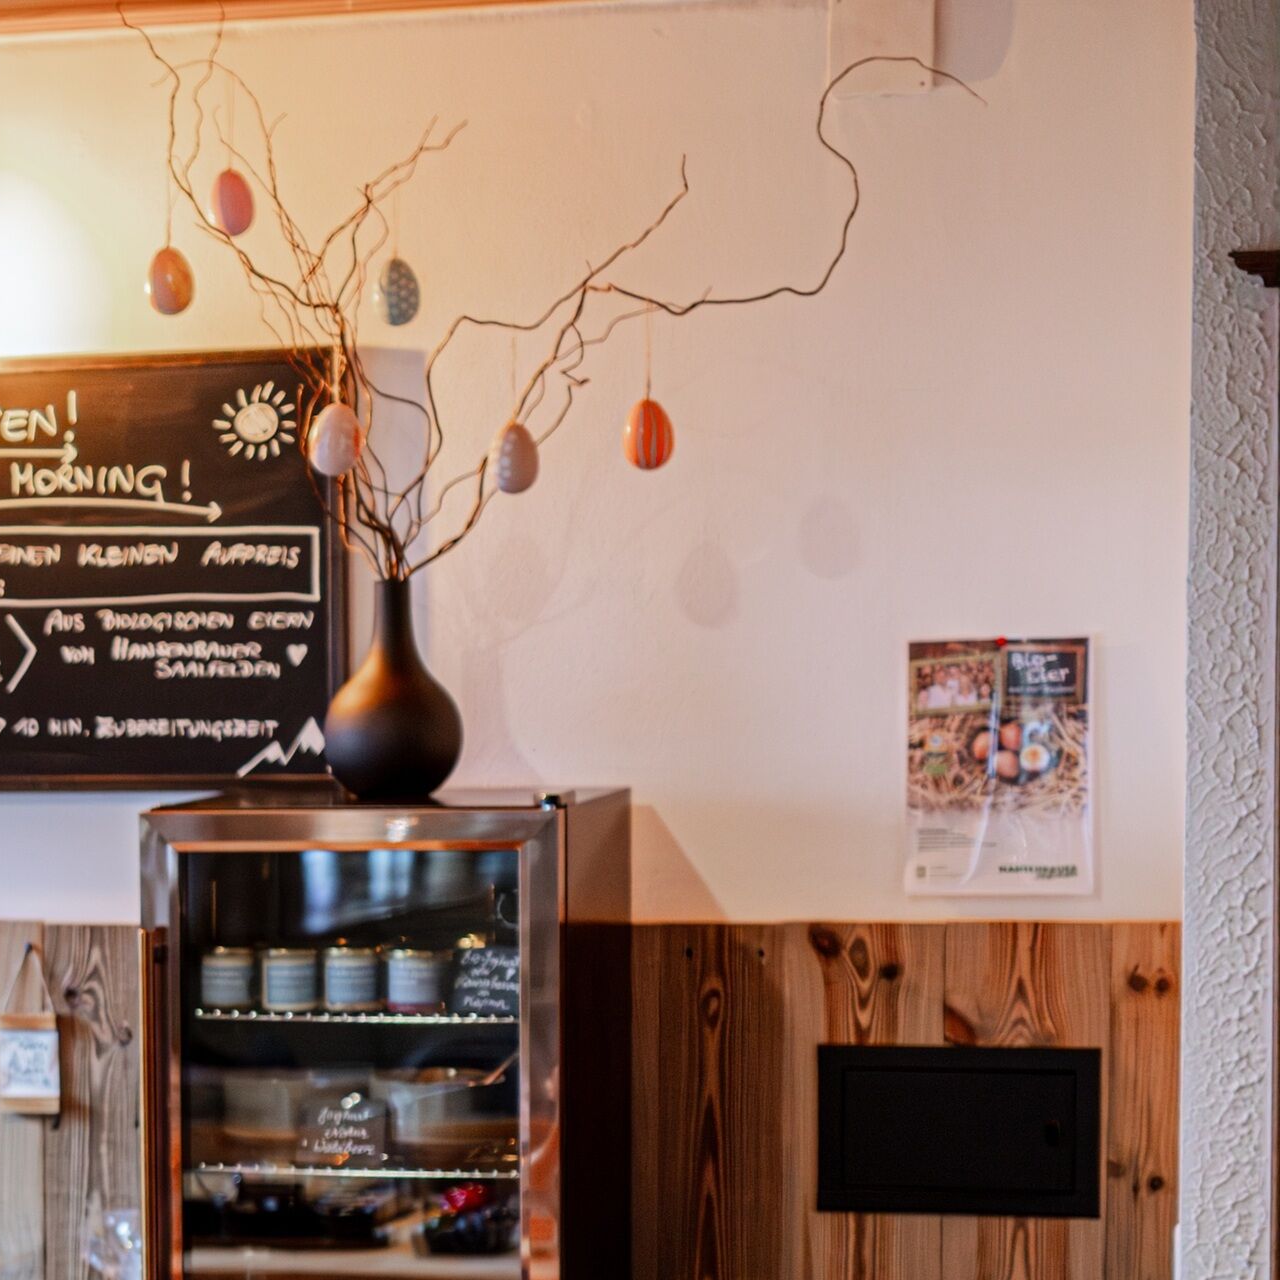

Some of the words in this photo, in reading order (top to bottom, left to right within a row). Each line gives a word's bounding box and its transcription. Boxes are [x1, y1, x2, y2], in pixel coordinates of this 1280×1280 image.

[77, 541, 179, 569] KLEINEN
[200, 541, 302, 569] AUFPREIS
[43, 608, 86, 636] AUS
[153, 659, 281, 680] SAALFELDEN
[11, 716, 40, 737] 10
